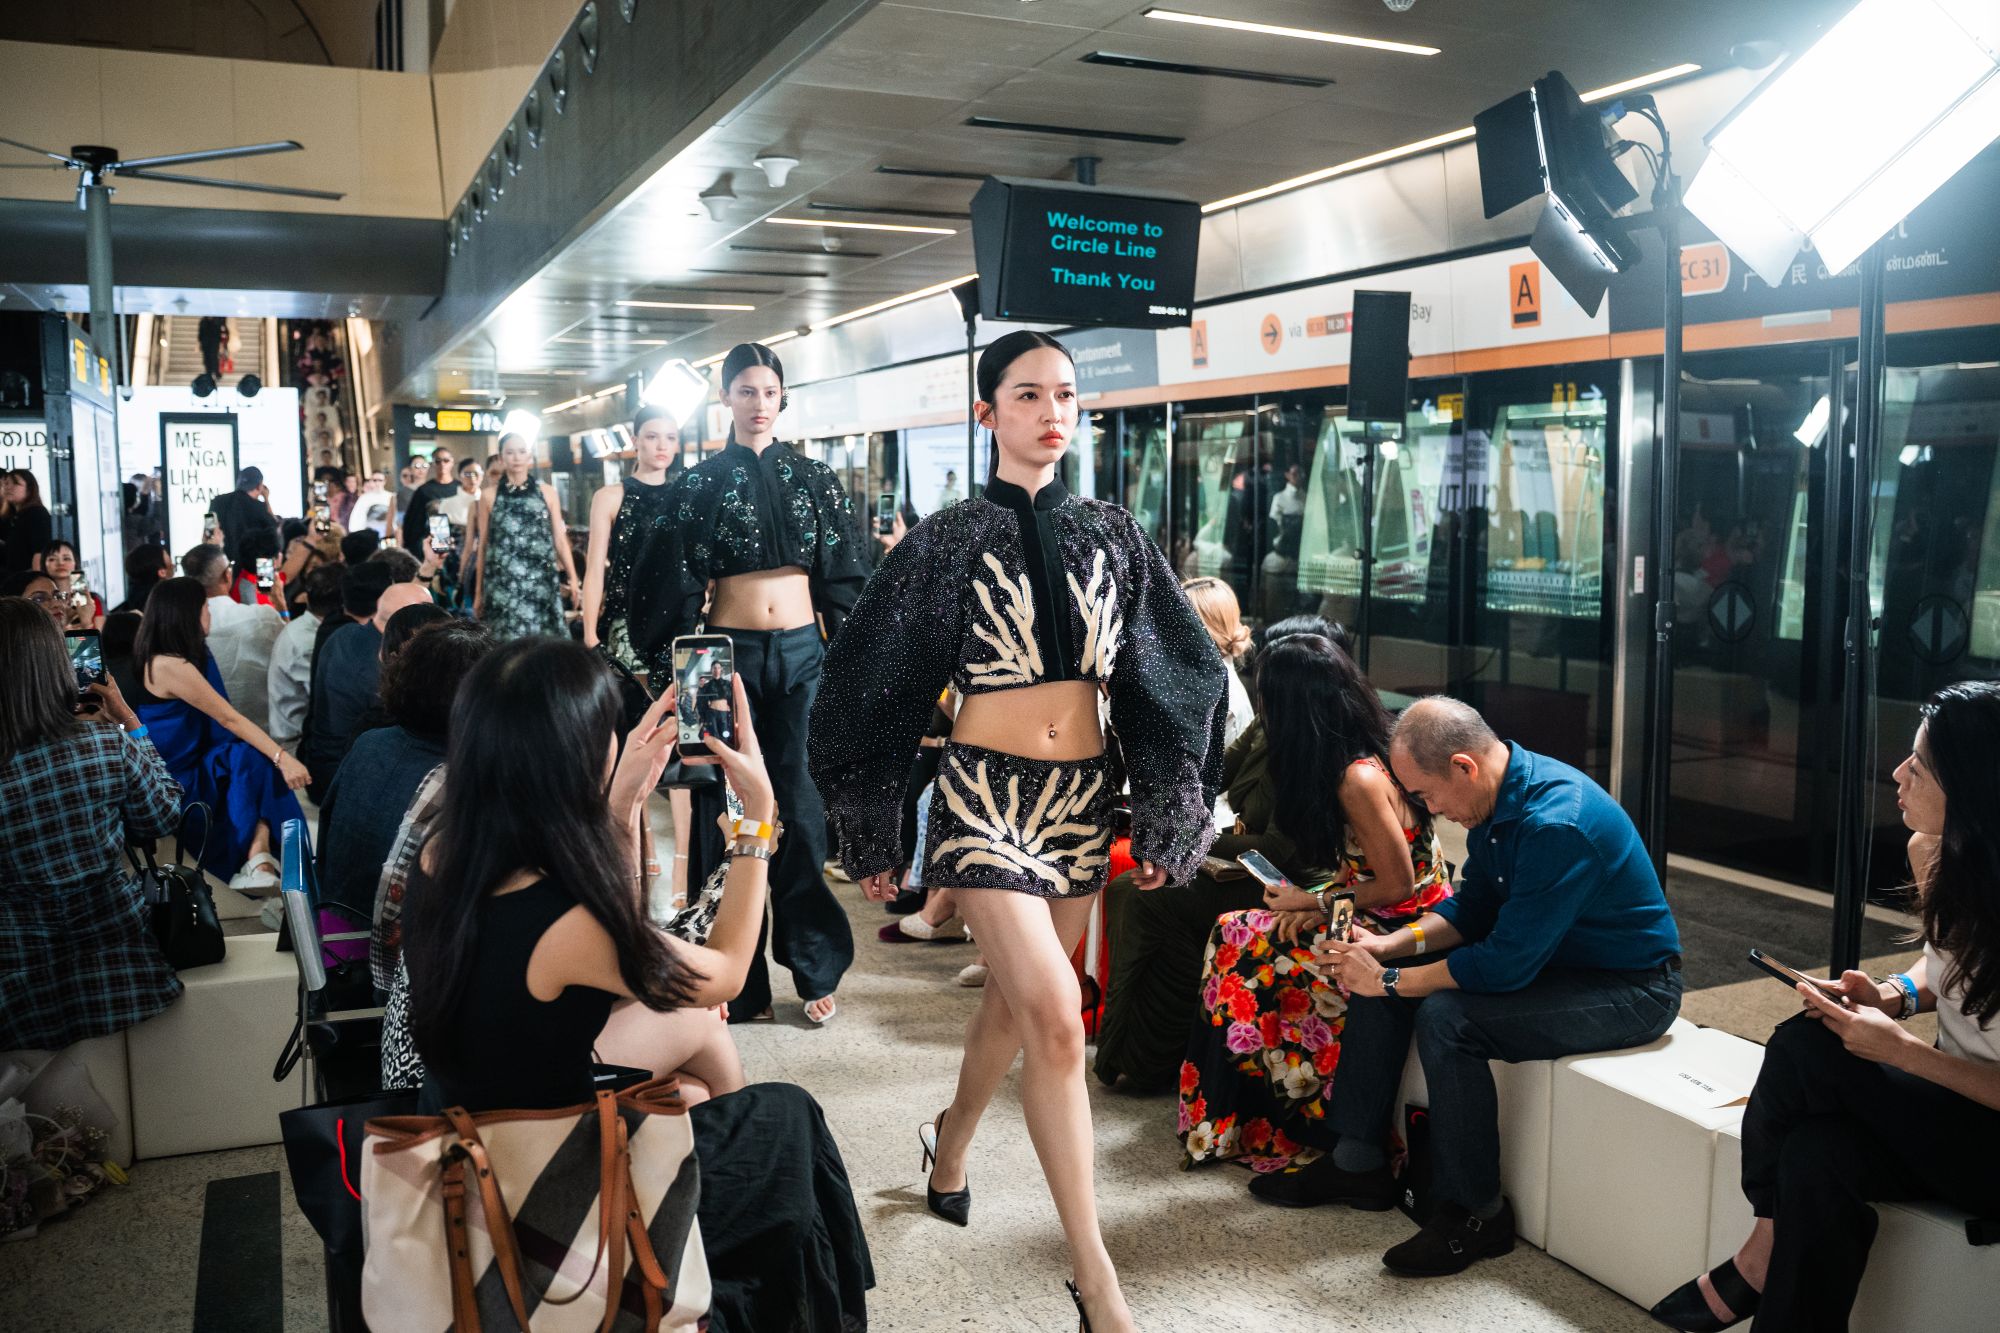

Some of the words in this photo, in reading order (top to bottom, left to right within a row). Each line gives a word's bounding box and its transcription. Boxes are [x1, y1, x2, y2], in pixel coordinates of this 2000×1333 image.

[1048, 212, 1138, 235] Welcome
[1144, 223, 1163, 237] to
[1051, 234, 1109, 254] Circle
[1115, 240, 1156, 258] Line
[1051, 268, 1111, 287] Thank
[1118, 273, 1155, 291] You
[1517, 274, 1534, 307] A
[1411, 303, 1432, 324] Bay
[1195, 330, 1204, 353] A
[175, 432, 201, 448] ME
[189, 451, 227, 467] NGA
[170, 469, 198, 486] LIH
